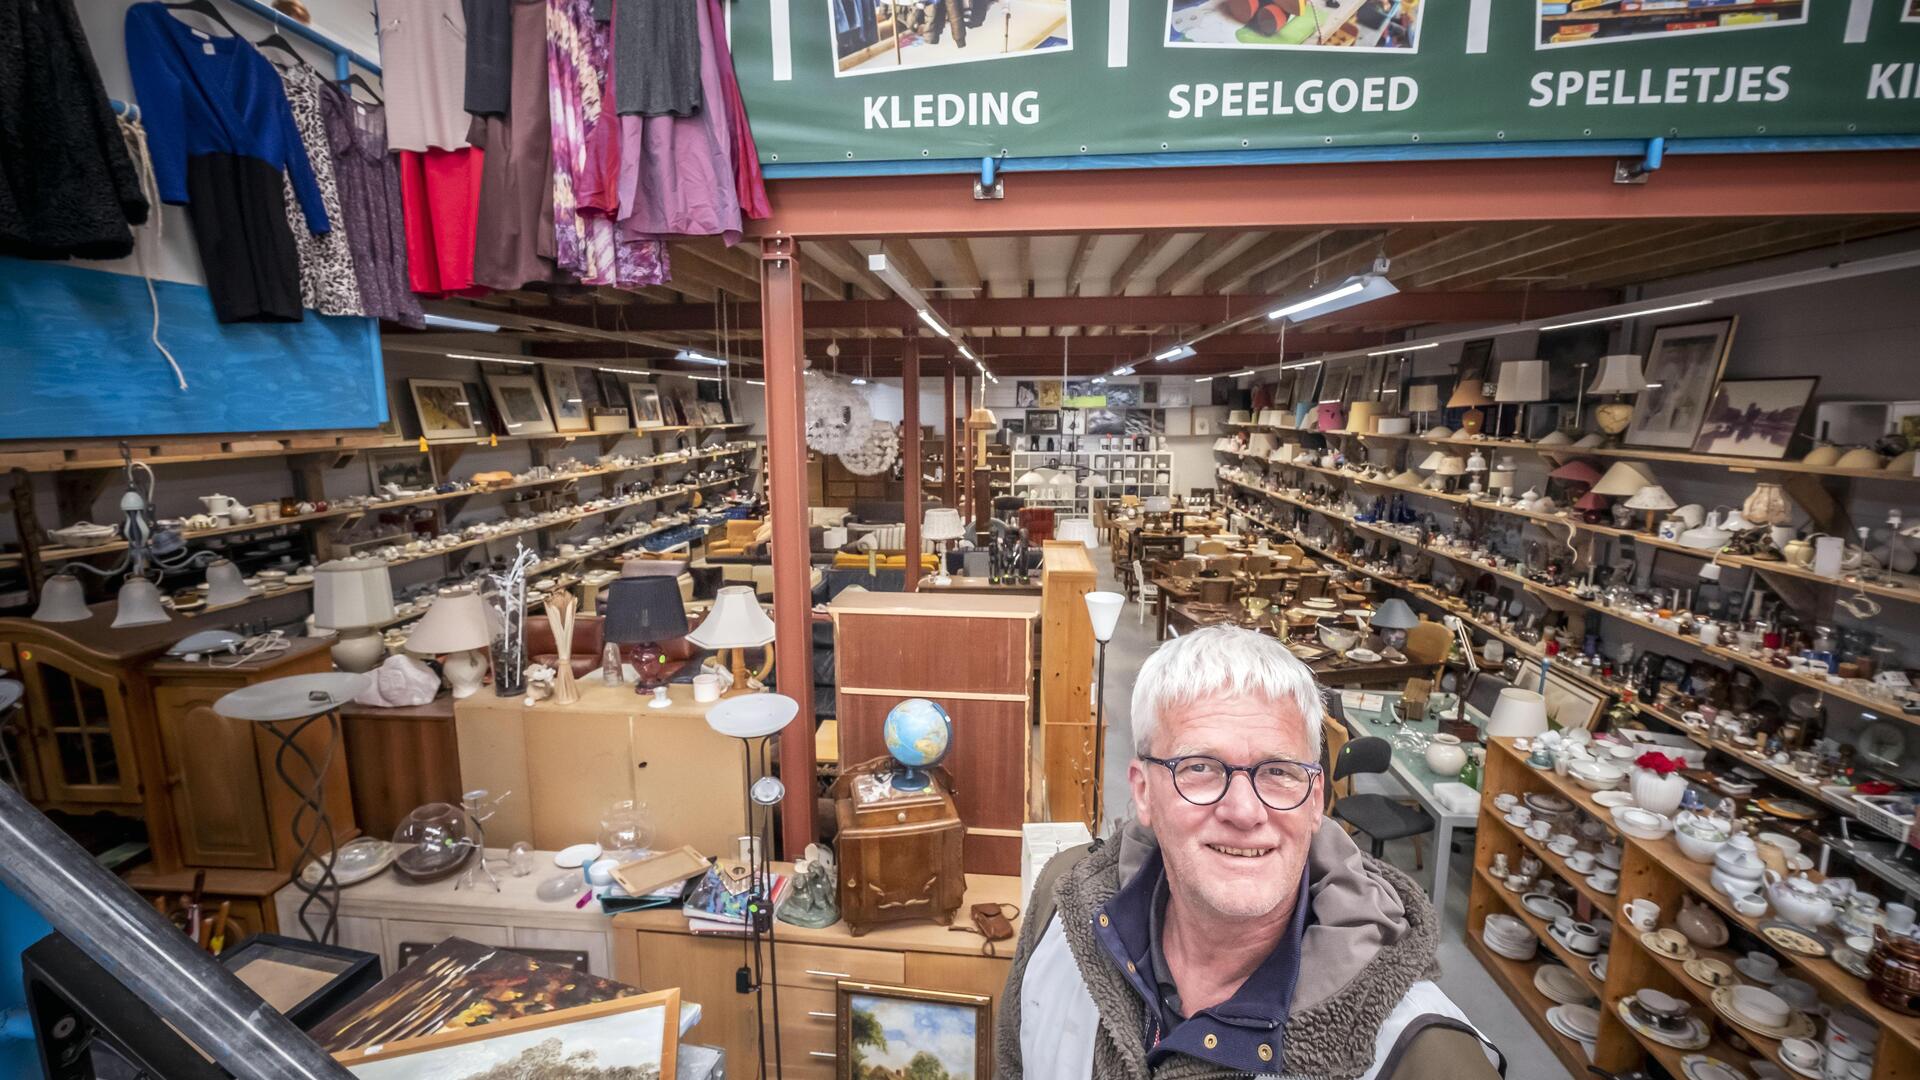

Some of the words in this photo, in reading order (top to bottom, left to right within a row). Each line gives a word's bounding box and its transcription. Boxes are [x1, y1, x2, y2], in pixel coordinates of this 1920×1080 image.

[1168, 76, 1419, 120] SPEELGOED
[1528, 65, 1791, 108] SPELLETJES
[1866, 63, 1920, 99] KI
[864, 90, 1040, 130] KLEDING
